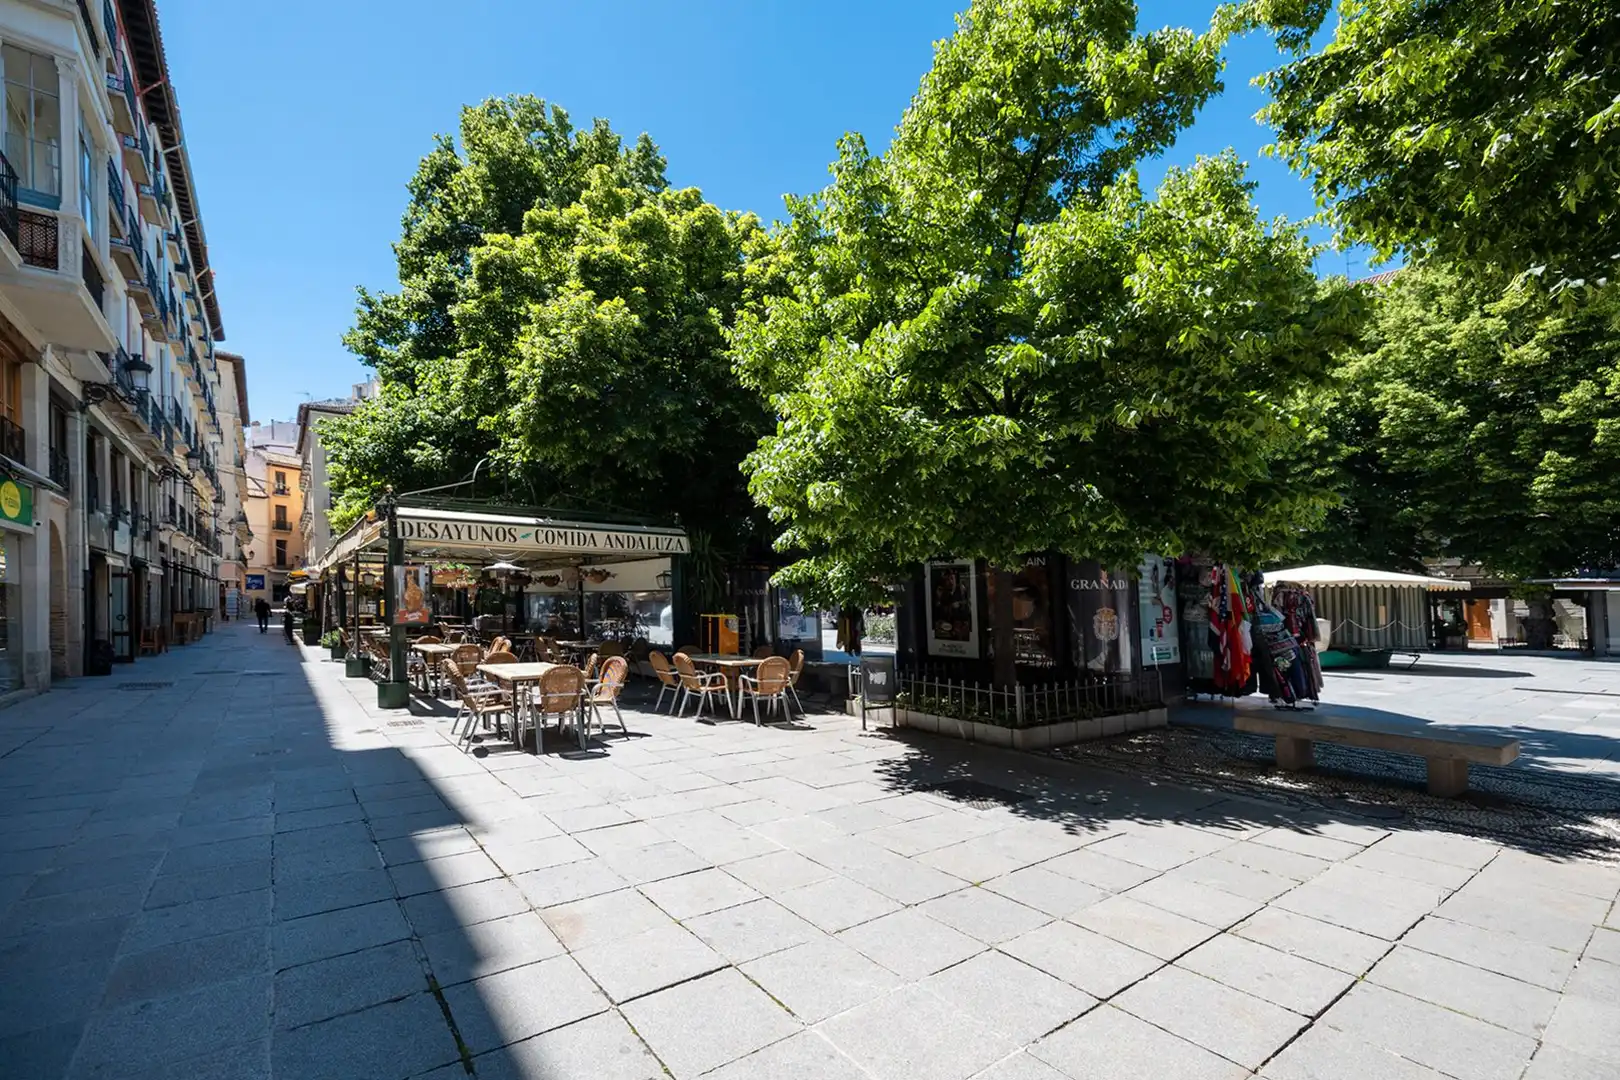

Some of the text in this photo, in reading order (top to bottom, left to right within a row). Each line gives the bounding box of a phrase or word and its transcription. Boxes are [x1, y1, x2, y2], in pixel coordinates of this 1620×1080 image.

[400, 520, 684, 552] DESAYUNOS COMIDA ANDALUZA
